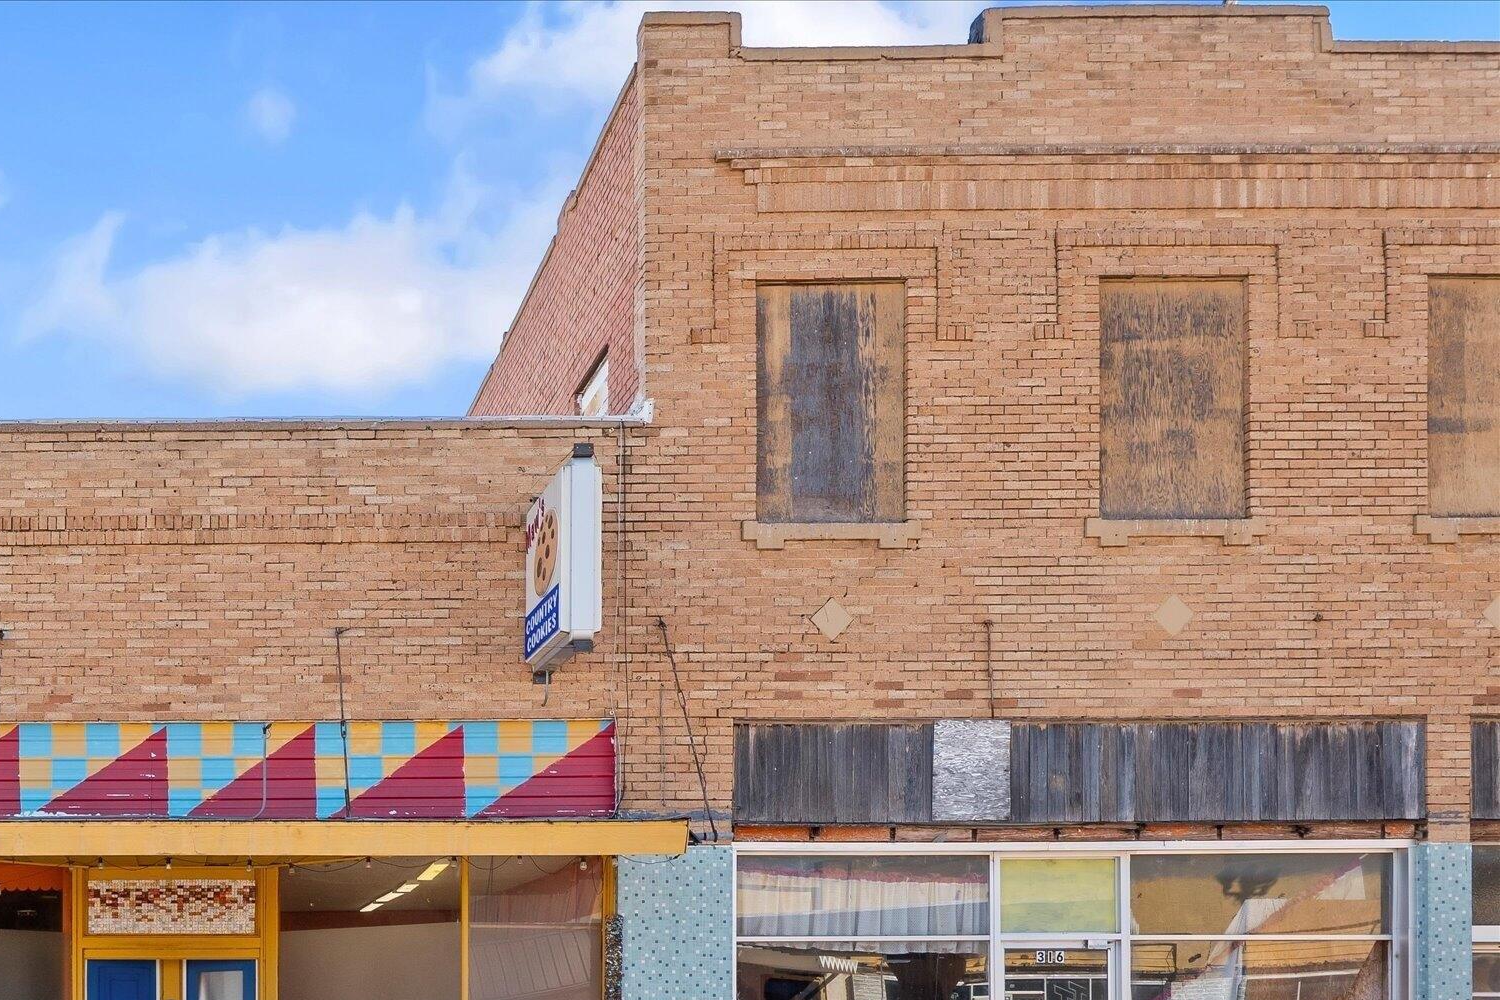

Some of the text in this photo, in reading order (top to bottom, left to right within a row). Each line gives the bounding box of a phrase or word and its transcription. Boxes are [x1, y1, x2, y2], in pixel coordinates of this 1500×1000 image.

[526, 589, 558, 635] COUNTRY
[527, 612, 557, 652] COOKIES
[1037, 951, 1064, 963] 316
